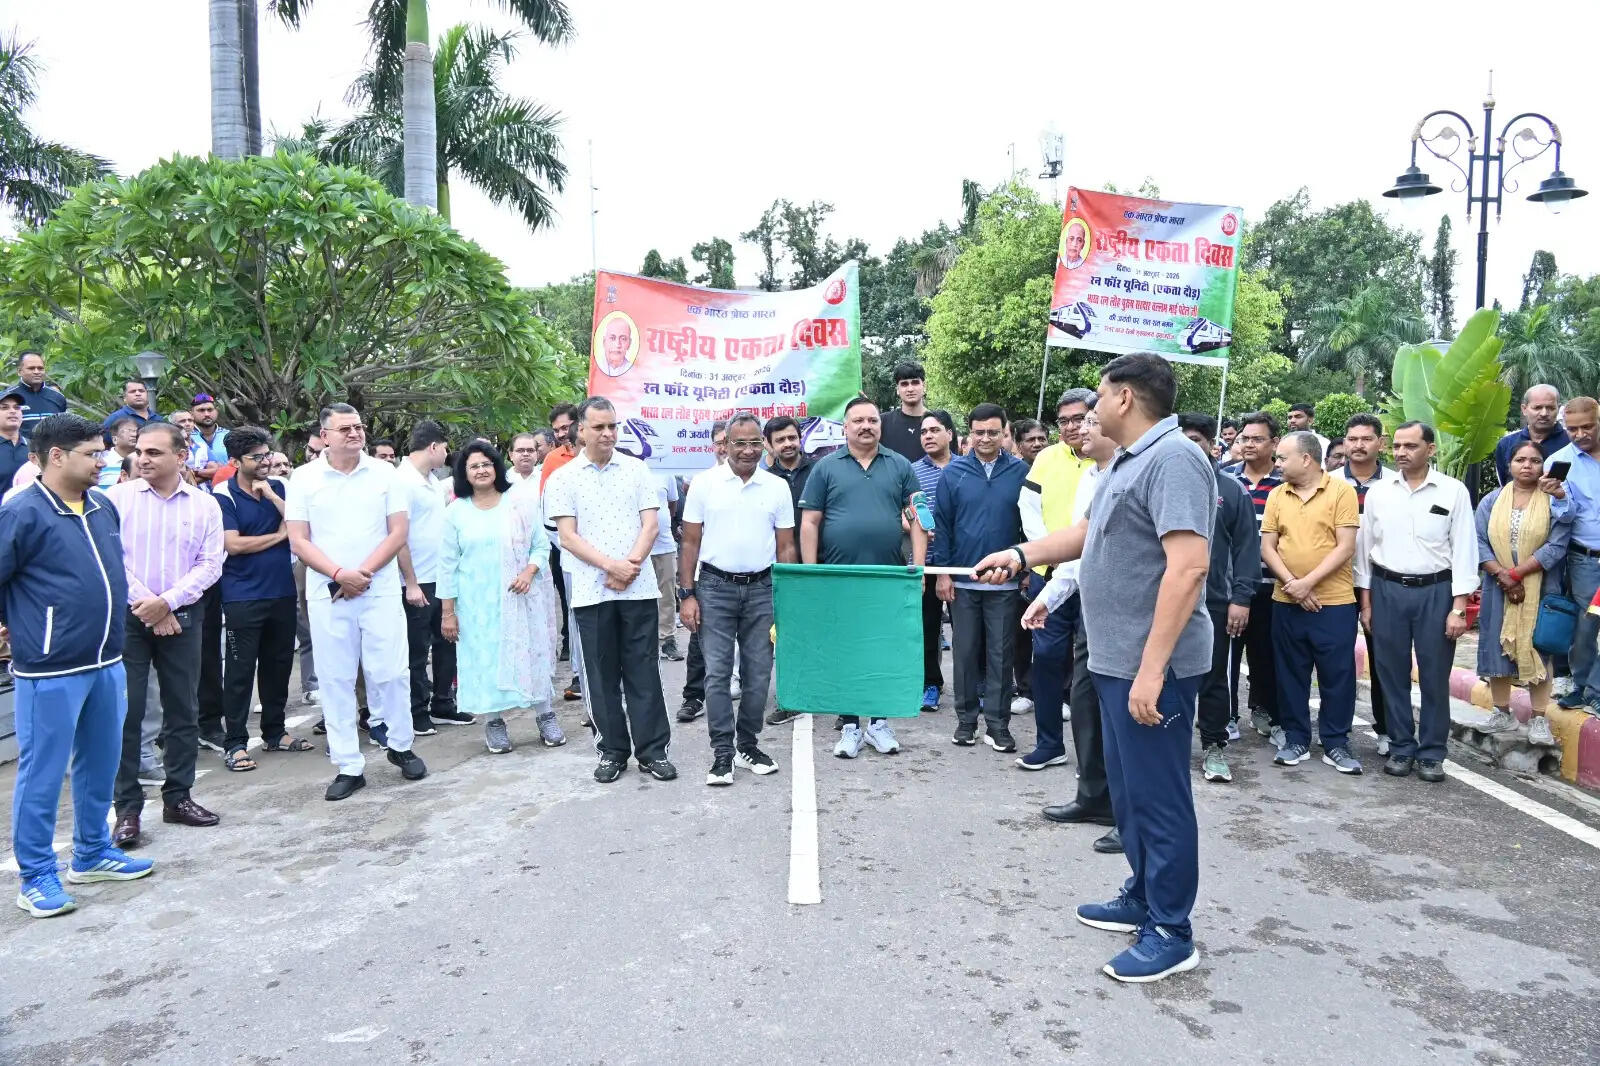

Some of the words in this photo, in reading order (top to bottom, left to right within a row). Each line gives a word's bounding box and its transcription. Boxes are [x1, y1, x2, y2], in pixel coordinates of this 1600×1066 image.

[1135, 212, 1153, 222] भारत
[1168, 217, 1185, 226] भारत
[1095, 229, 1140, 260] राष्ट्रीय
[1144, 239, 1190, 263] एकता
[1194, 236, 1235, 269] दिवस
[1090, 276, 1102, 286] रन
[1104, 276, 1121, 289] फॉर
[1123, 278, 1150, 293] यूनिटी
[1153, 284, 1182, 296] (एकता
[1183, 284, 1201, 302] दौड़)
[687, 304, 702, 315] एक
[704, 307, 728, 319] भारत
[752, 310, 776, 319] भारत
[1135, 299, 1151, 312] सरदार
[646, 326, 717, 363] राष्ट्रीय
[724, 334, 786, 361] एकता
[791, 318, 850, 350] दिवस
[709, 372, 719, 381] 31
[643, 382, 660, 395] रन
[664, 381, 689, 397] फॉर
[692, 386, 731, 402] यूनिटी
[735, 382, 776, 399] (एकता
[779, 378, 807, 397] दौड़)
[641, 406, 659, 419] भारत
[692, 408, 712, 425] पुरुष
[762, 401, 776, 420] भाई
[796, 401, 808, 417] जी
[677, 428, 688, 439] की
